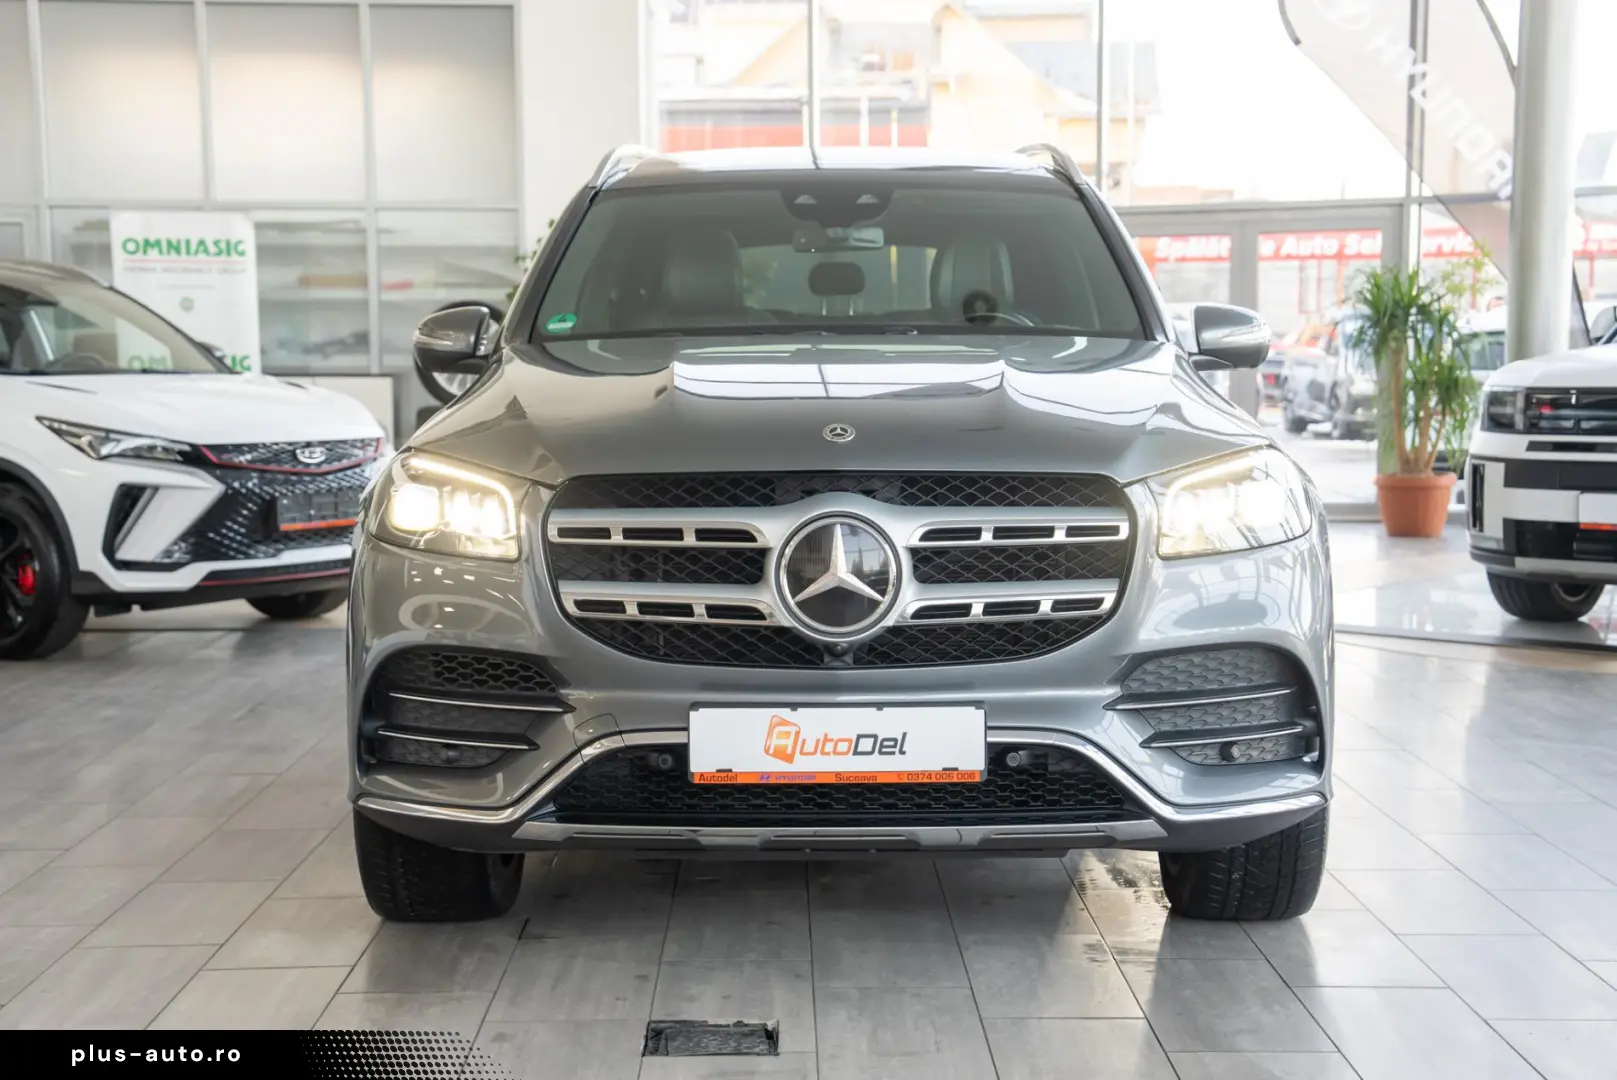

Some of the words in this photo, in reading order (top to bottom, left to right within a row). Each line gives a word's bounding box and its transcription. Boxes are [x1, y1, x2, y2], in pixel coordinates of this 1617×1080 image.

[121, 237, 246, 257] OMNIASIG
[1279, 236, 1337, 255] Auto
[1343, 233, 1382, 254] Sel
[769, 726, 907, 756] AutoDel
[698, 773, 738, 782] Autodel
[834, 773, 878, 782] Suceava
[907, 773, 932, 781] 0374
[935, 772, 954, 781] 006
[956, 772, 976, 780] 006
